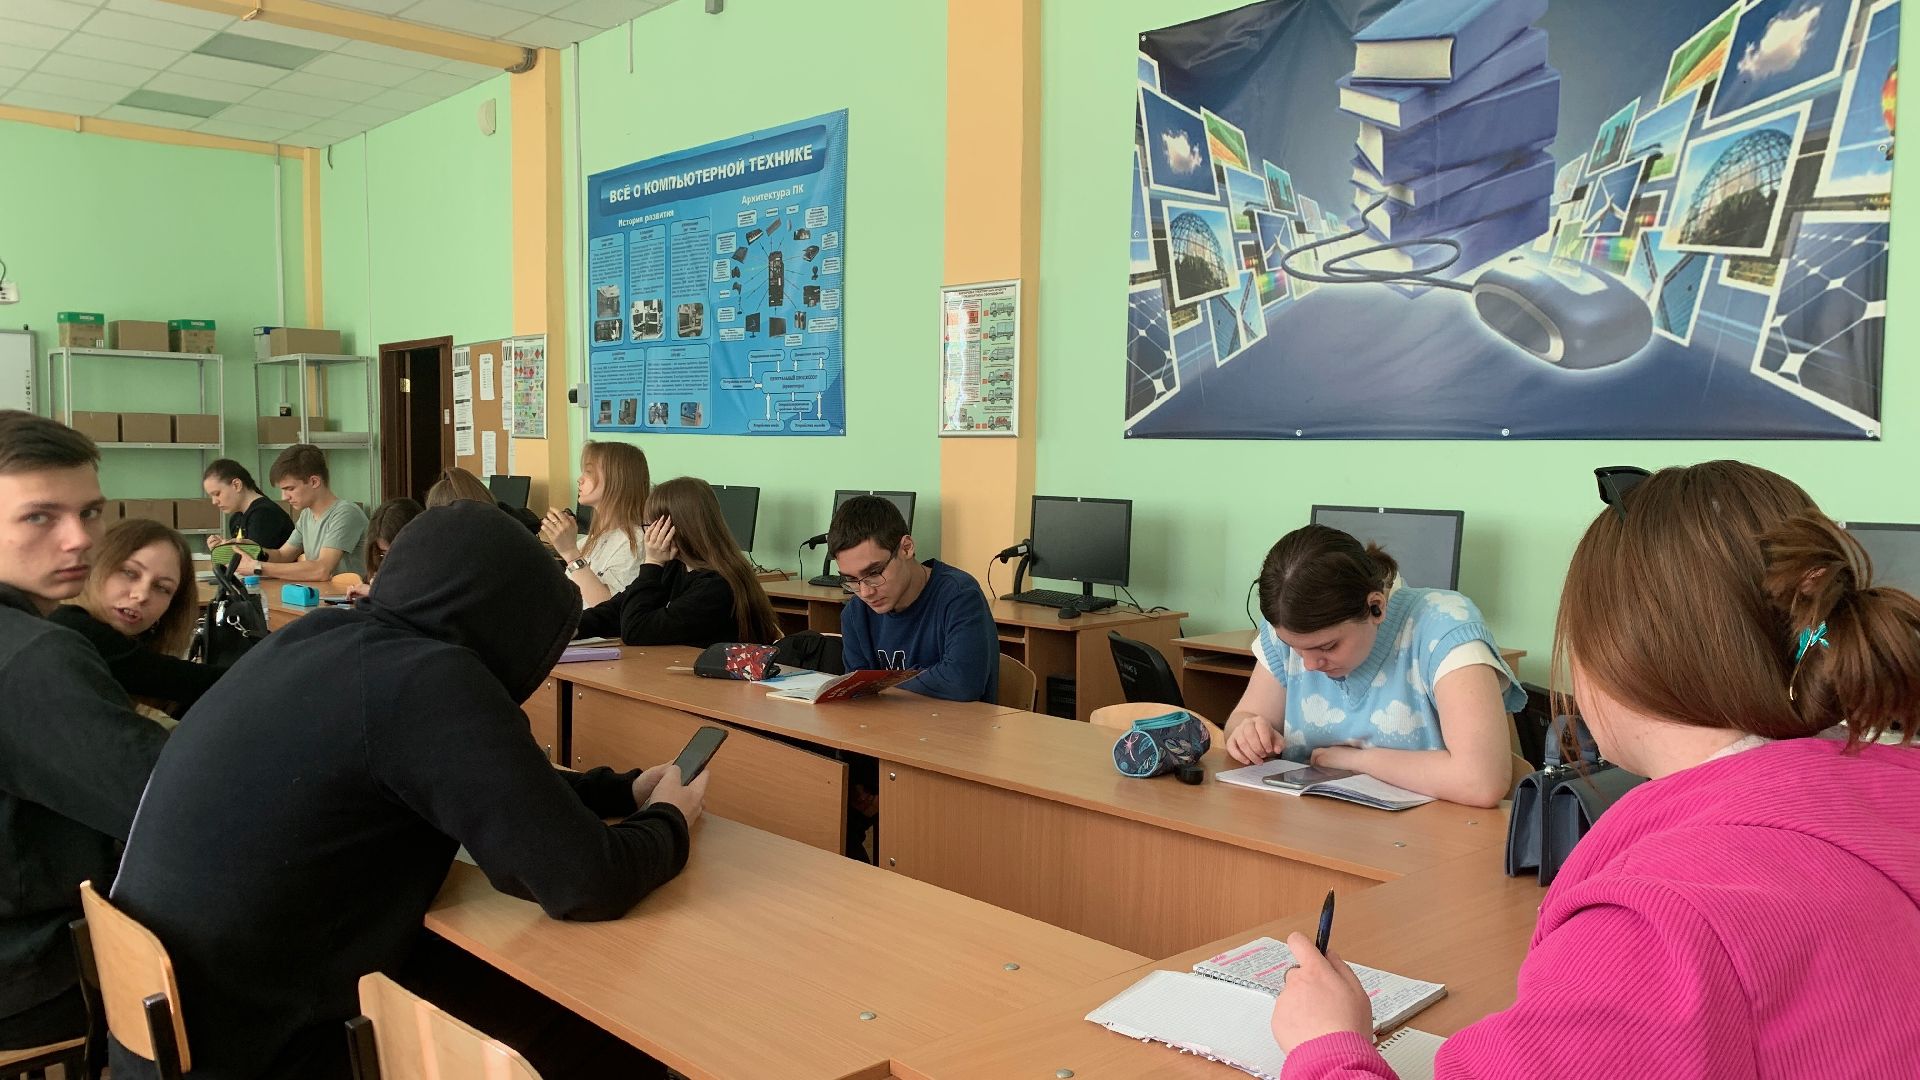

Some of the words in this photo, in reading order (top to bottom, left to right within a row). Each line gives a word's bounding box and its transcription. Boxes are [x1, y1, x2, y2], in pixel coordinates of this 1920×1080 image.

[609, 184, 631, 203] ВСЁ
[633, 184, 641, 198] О
[644, 157, 745, 196] КОМПЬЮТЕРНОЙ
[749, 144, 813, 172] ТЕХНИКЕ
[741, 188, 791, 206] Архитектура
[792, 183, 804, 195] ПК
[618, 217, 643, 227] История
[644, 210, 674, 224] развития
[877, 649, 906, 671] M
